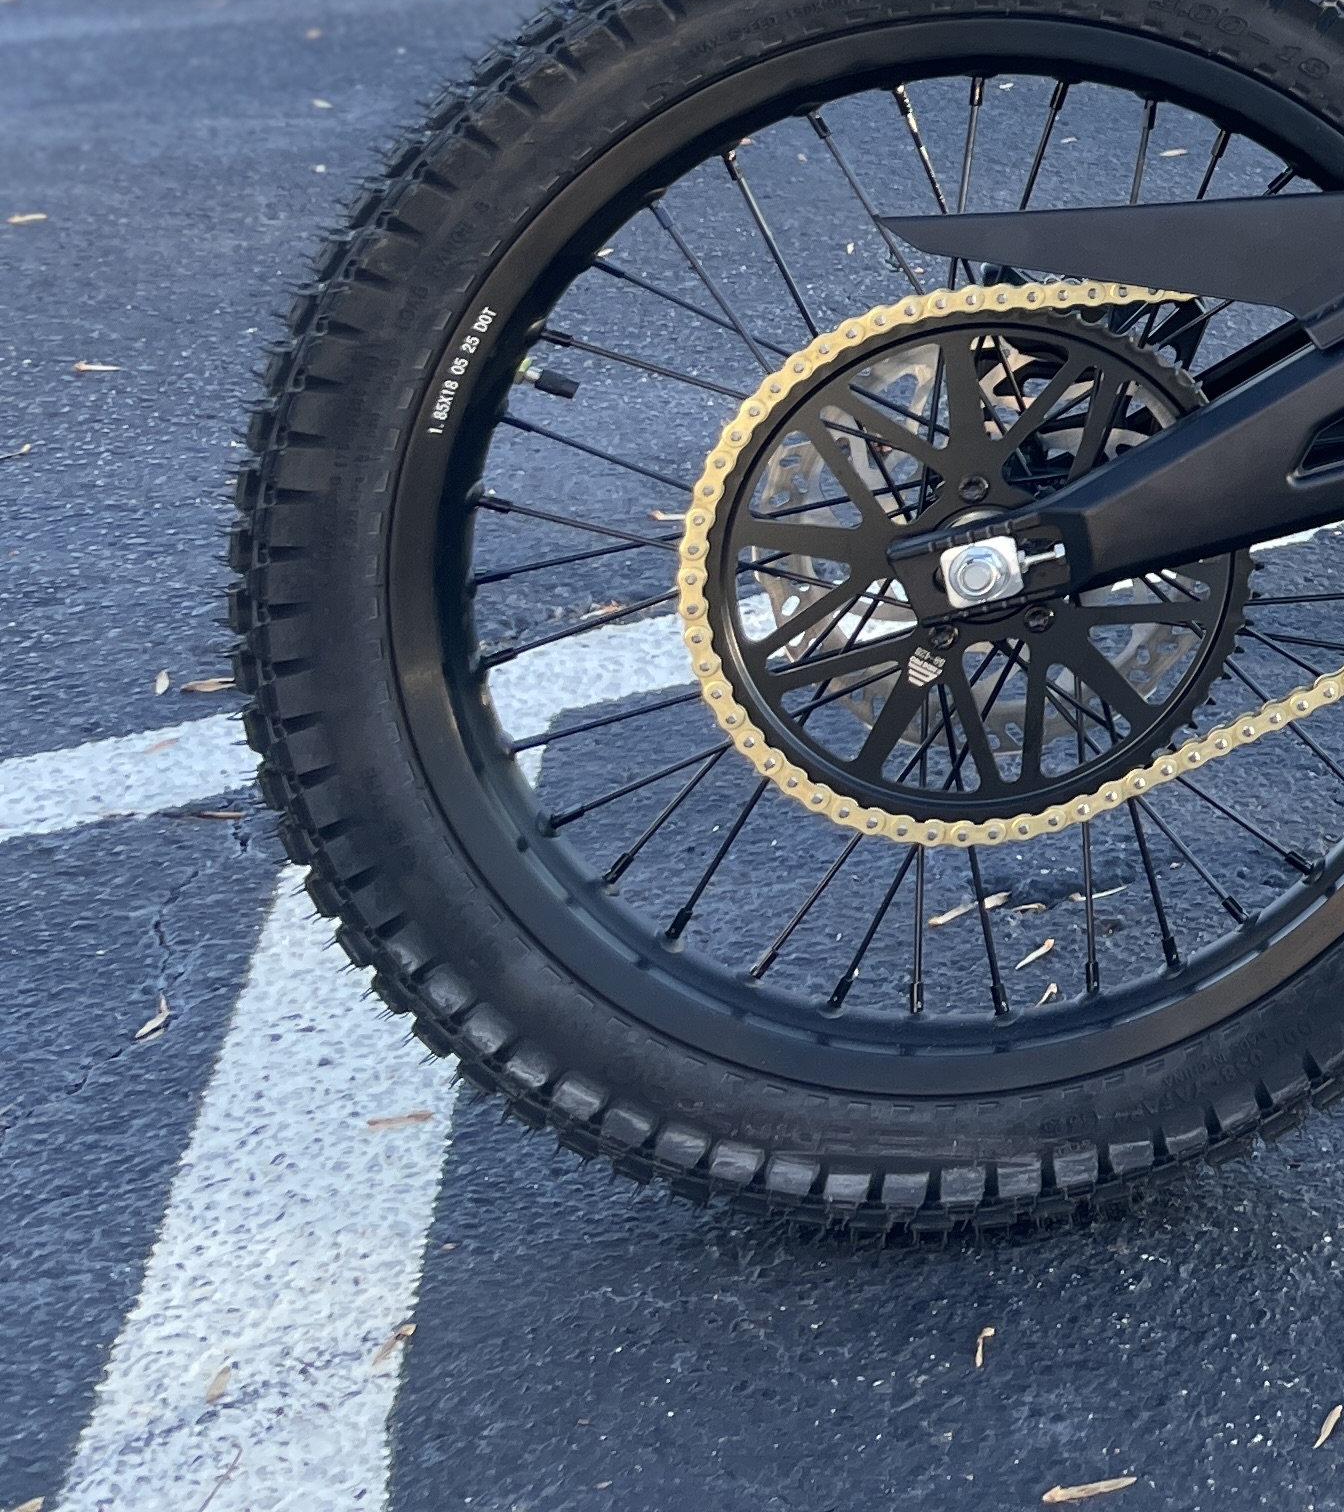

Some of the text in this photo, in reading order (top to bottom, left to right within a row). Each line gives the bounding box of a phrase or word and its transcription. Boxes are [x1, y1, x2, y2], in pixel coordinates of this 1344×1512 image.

[450, 357, 469, 375] 05
[461, 335, 480, 354] 25
[473, 306, 497, 332] DOT
